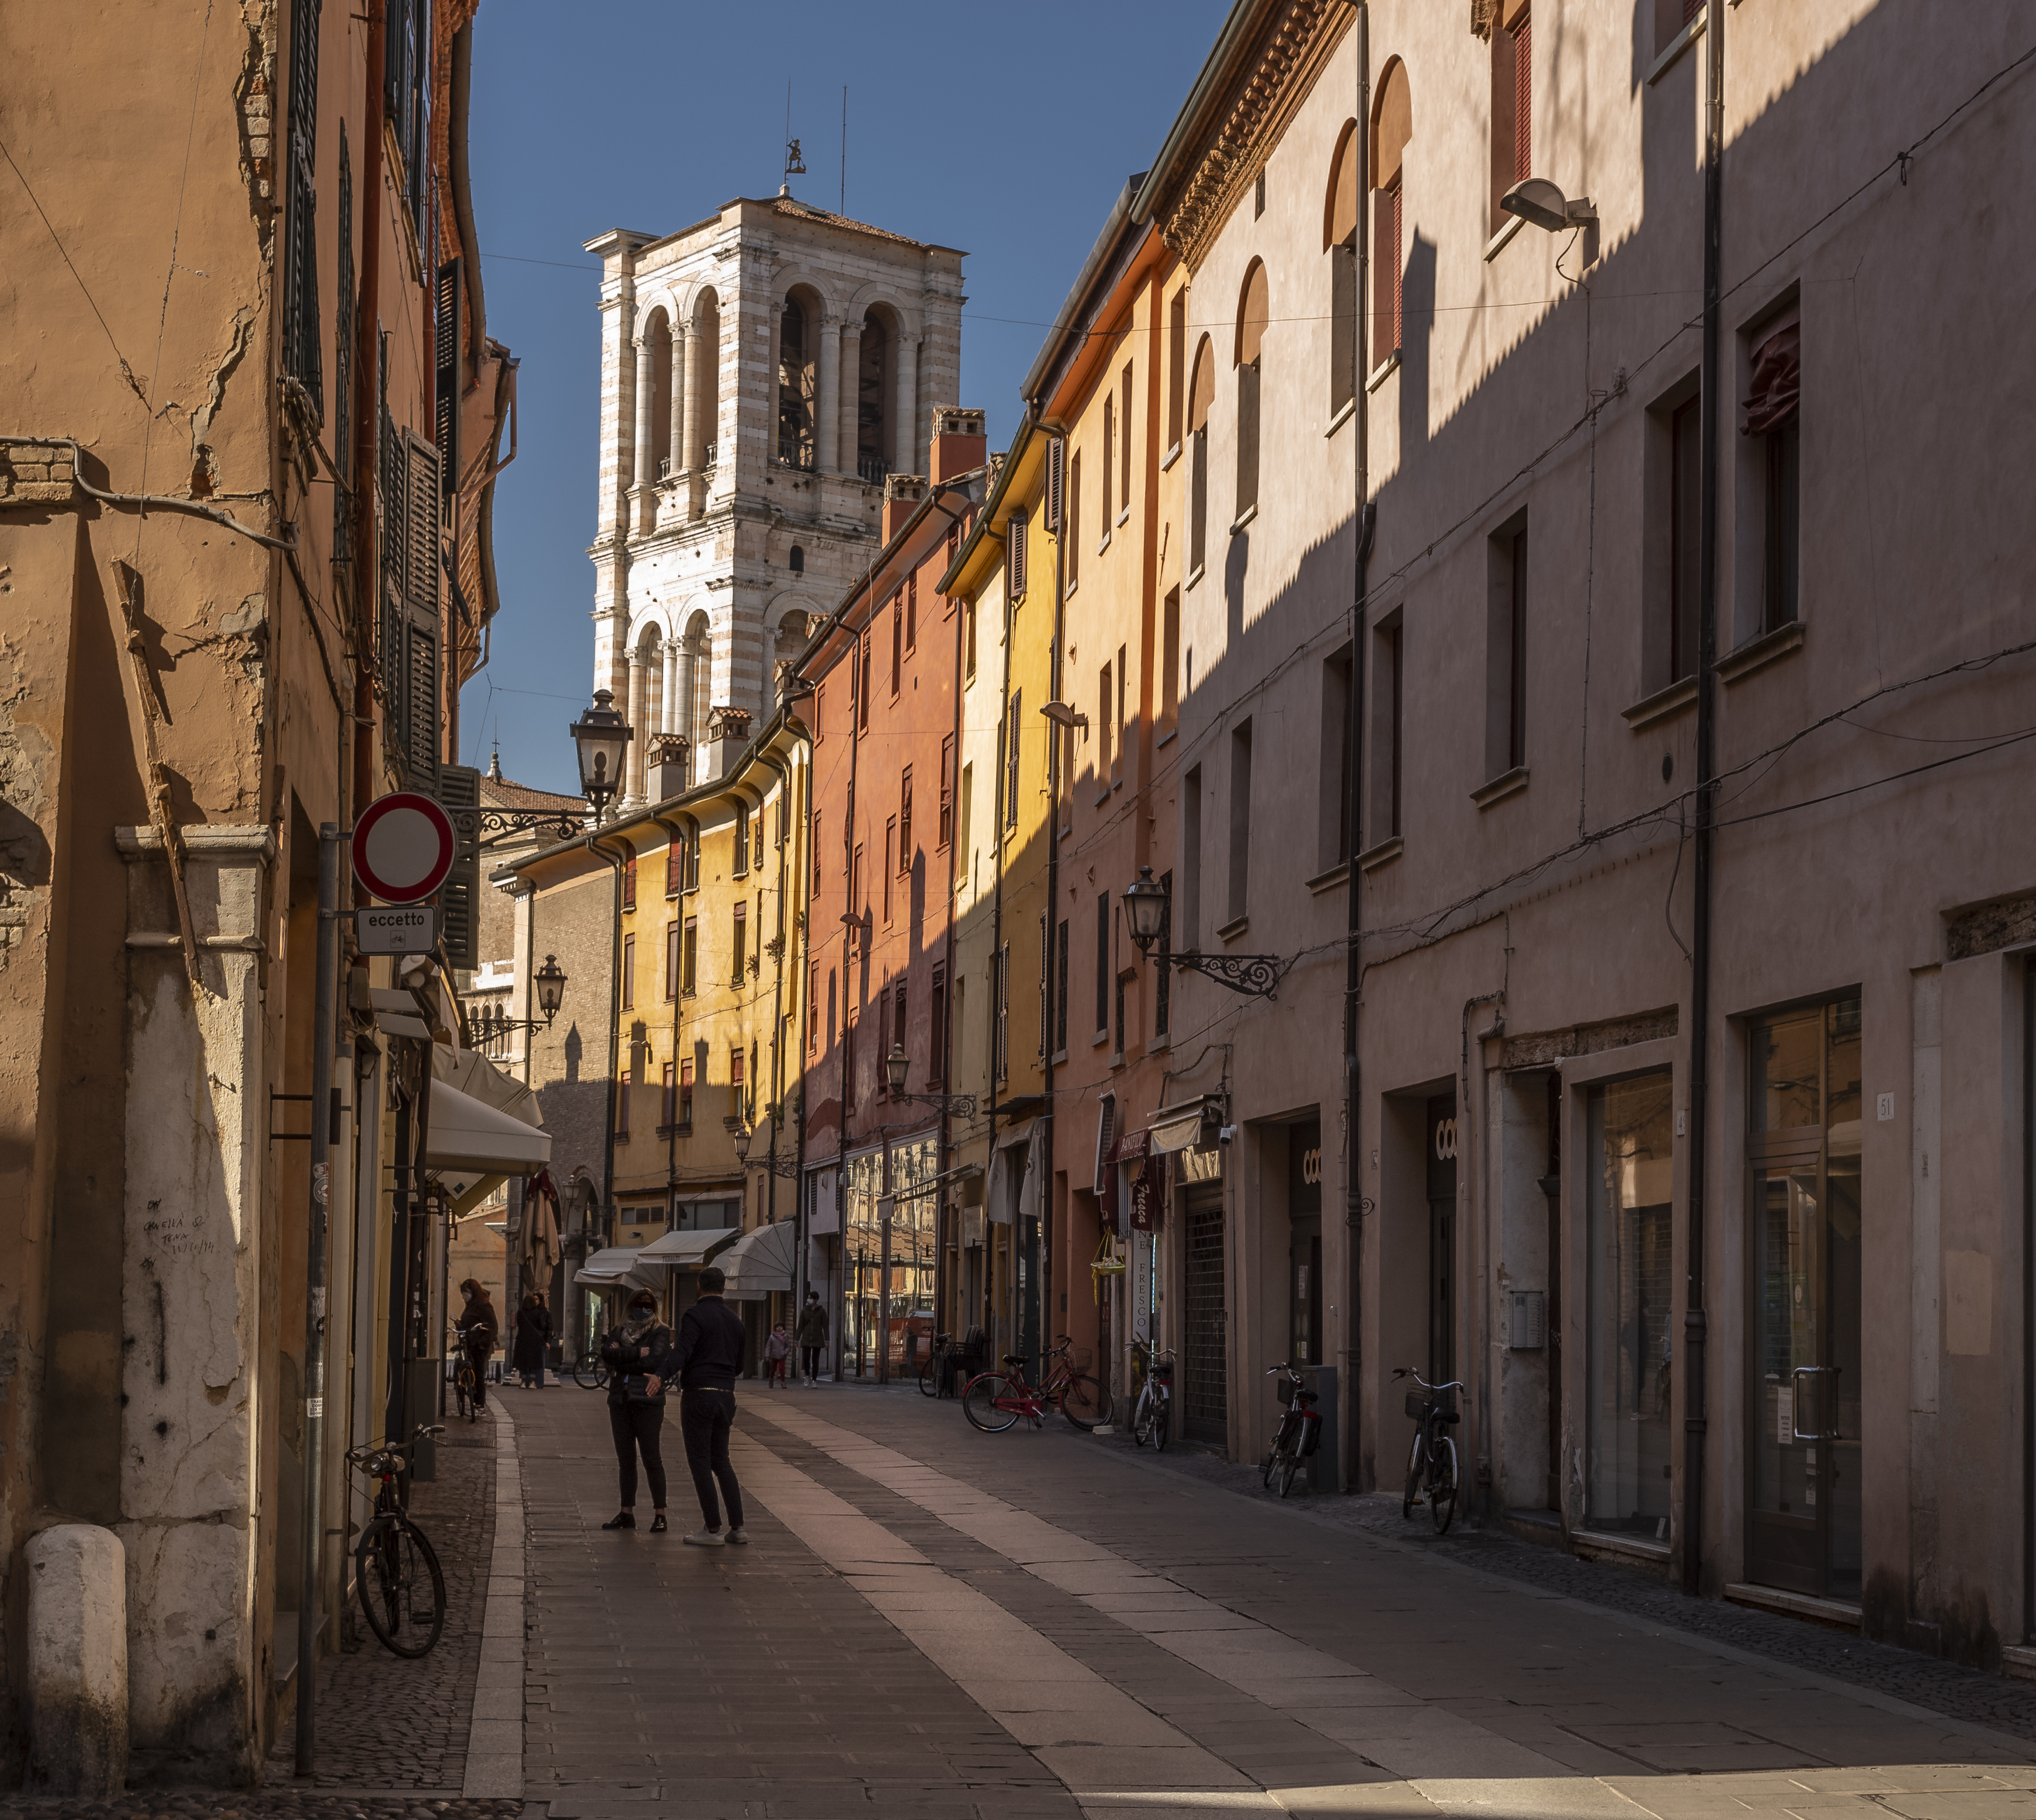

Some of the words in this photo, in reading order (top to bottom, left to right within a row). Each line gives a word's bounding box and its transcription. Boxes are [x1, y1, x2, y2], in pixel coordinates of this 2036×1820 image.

[369, 912, 425, 927] eccetto
[1881, 1097, 1890, 1116] 51
[1137, 1184, 1150, 1224] Fresca
[1137, 1263, 1146, 1327] FRESCO
